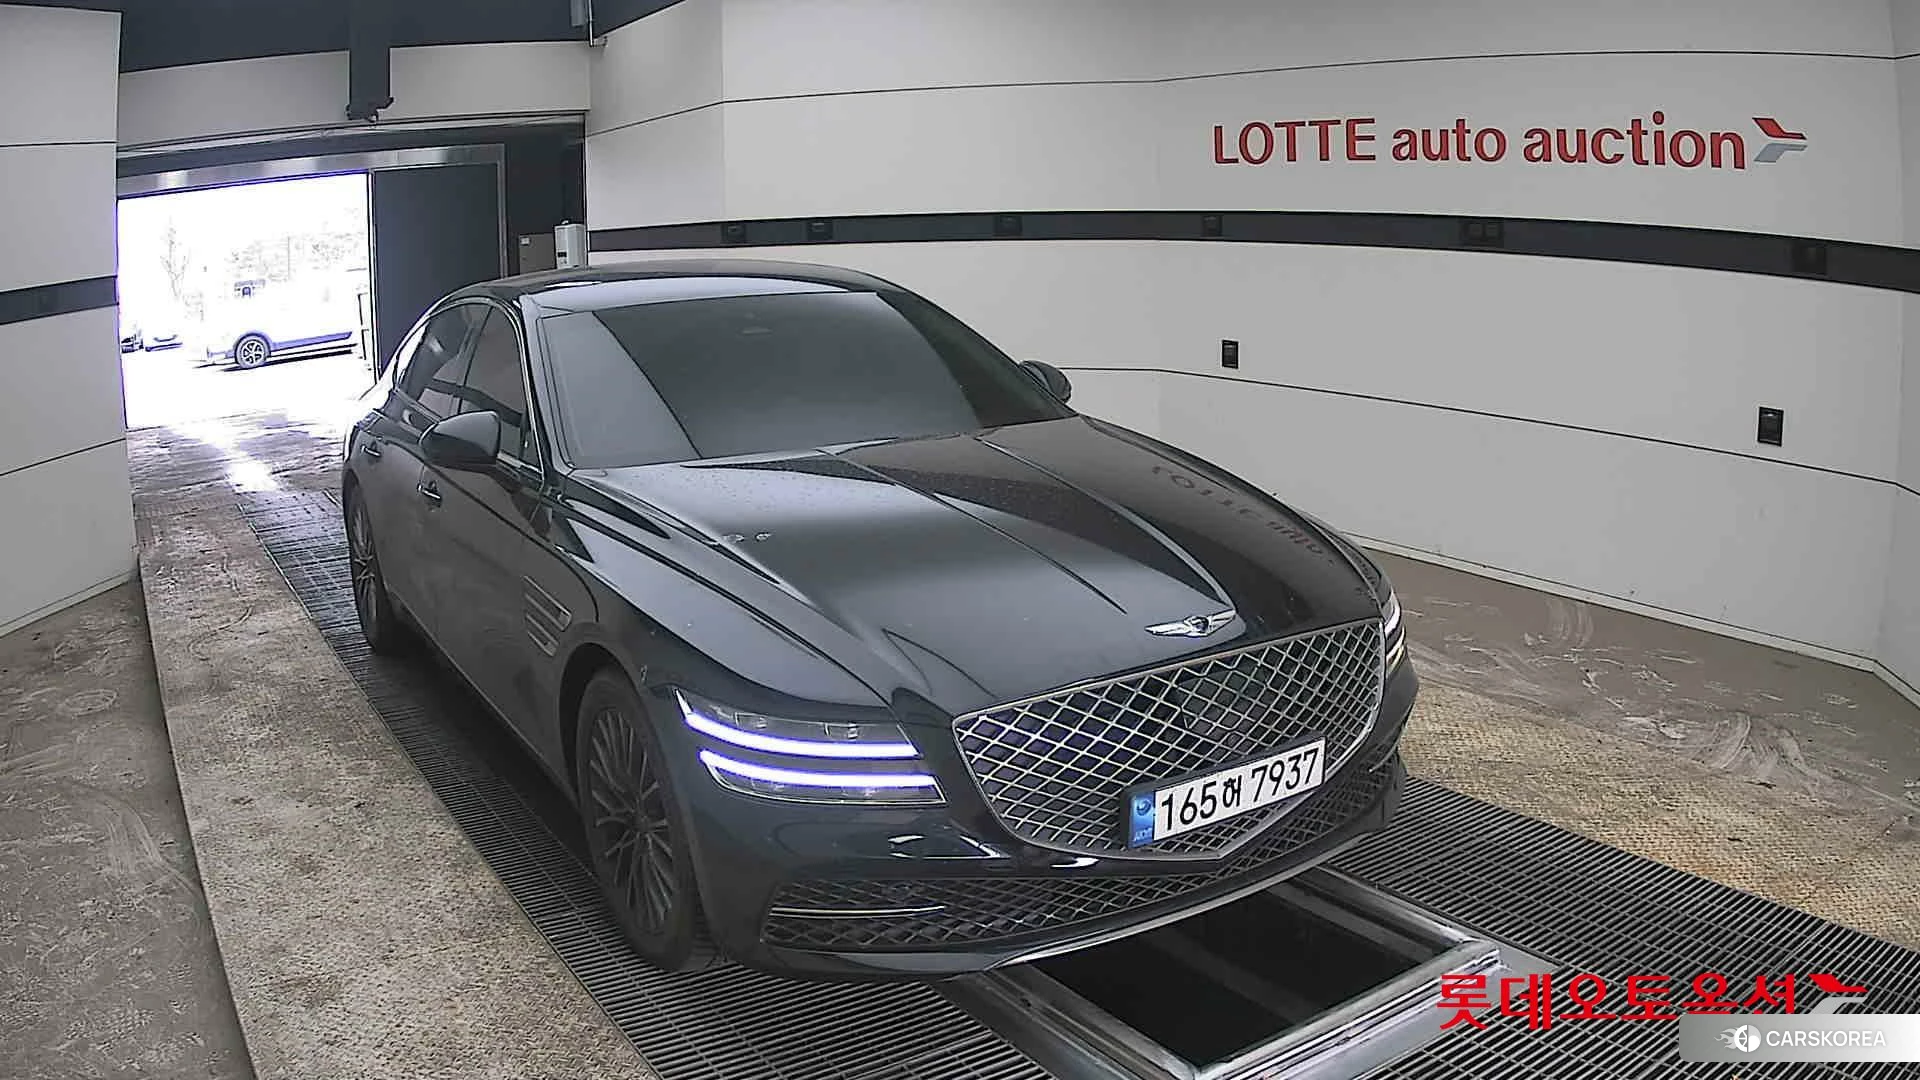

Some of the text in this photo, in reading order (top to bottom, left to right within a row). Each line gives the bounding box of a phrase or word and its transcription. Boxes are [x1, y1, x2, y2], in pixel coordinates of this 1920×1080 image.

[1213, 111, 1746, 169] LOTTE auto auction
[1251, 748, 1319, 803] 7937
